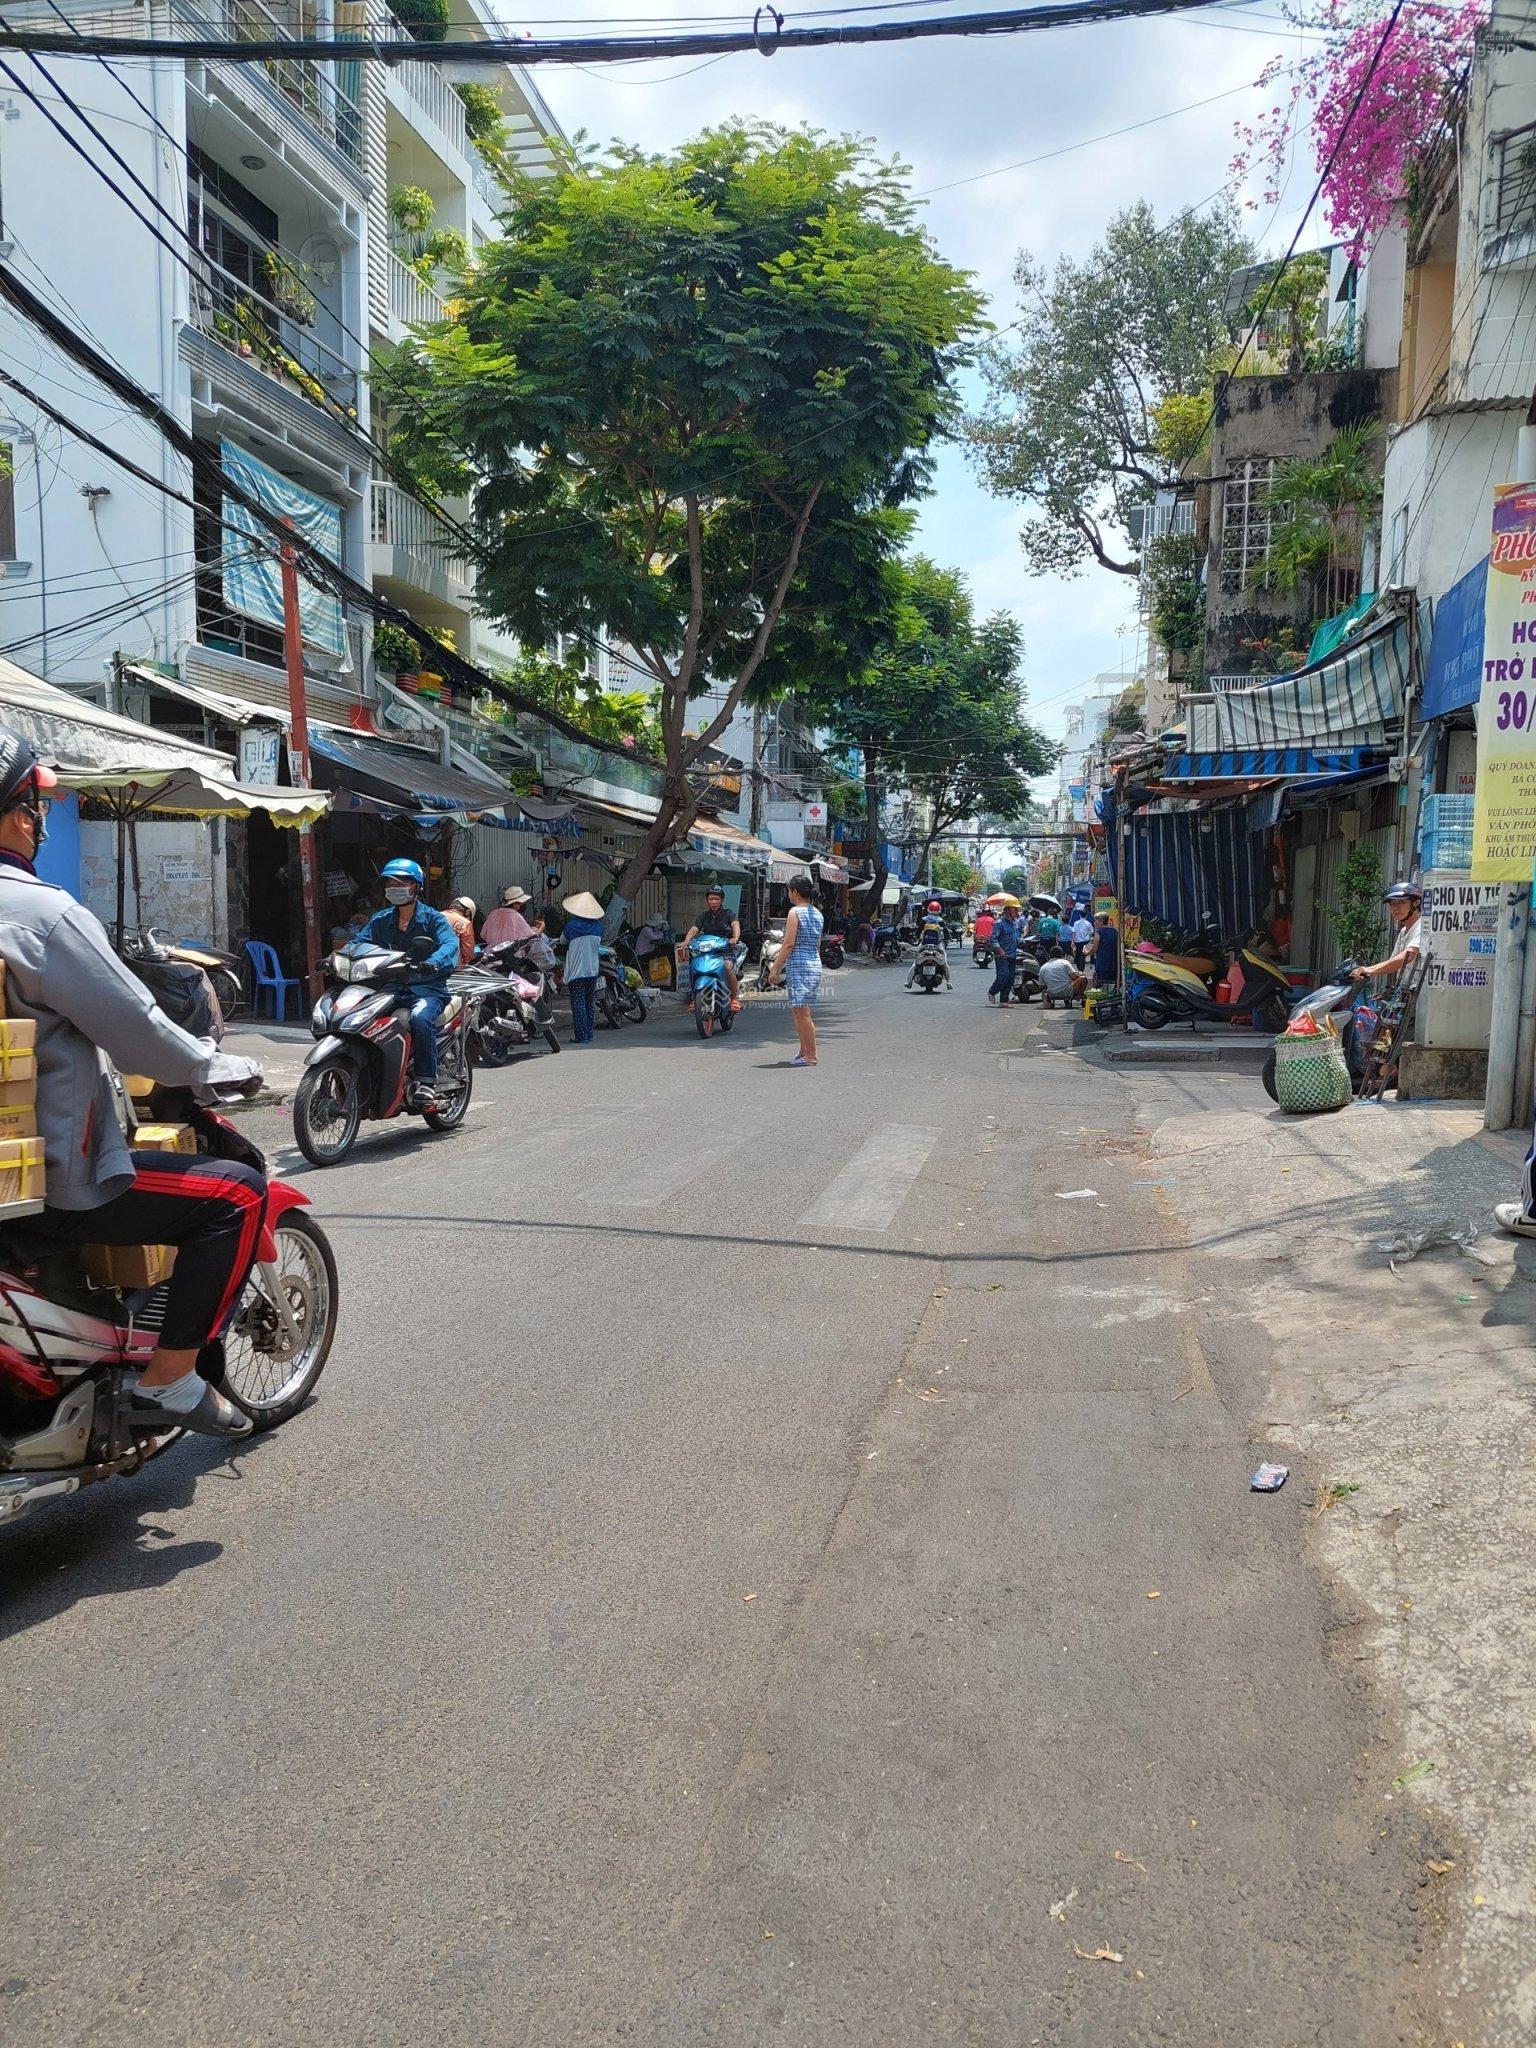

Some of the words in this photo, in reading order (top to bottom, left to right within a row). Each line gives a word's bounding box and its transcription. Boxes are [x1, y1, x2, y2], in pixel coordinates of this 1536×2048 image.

[1485, 652, 1526, 682] TRỞ
[1433, 887, 1455, 906] CHO
[1459, 886, 1481, 905] VAY
